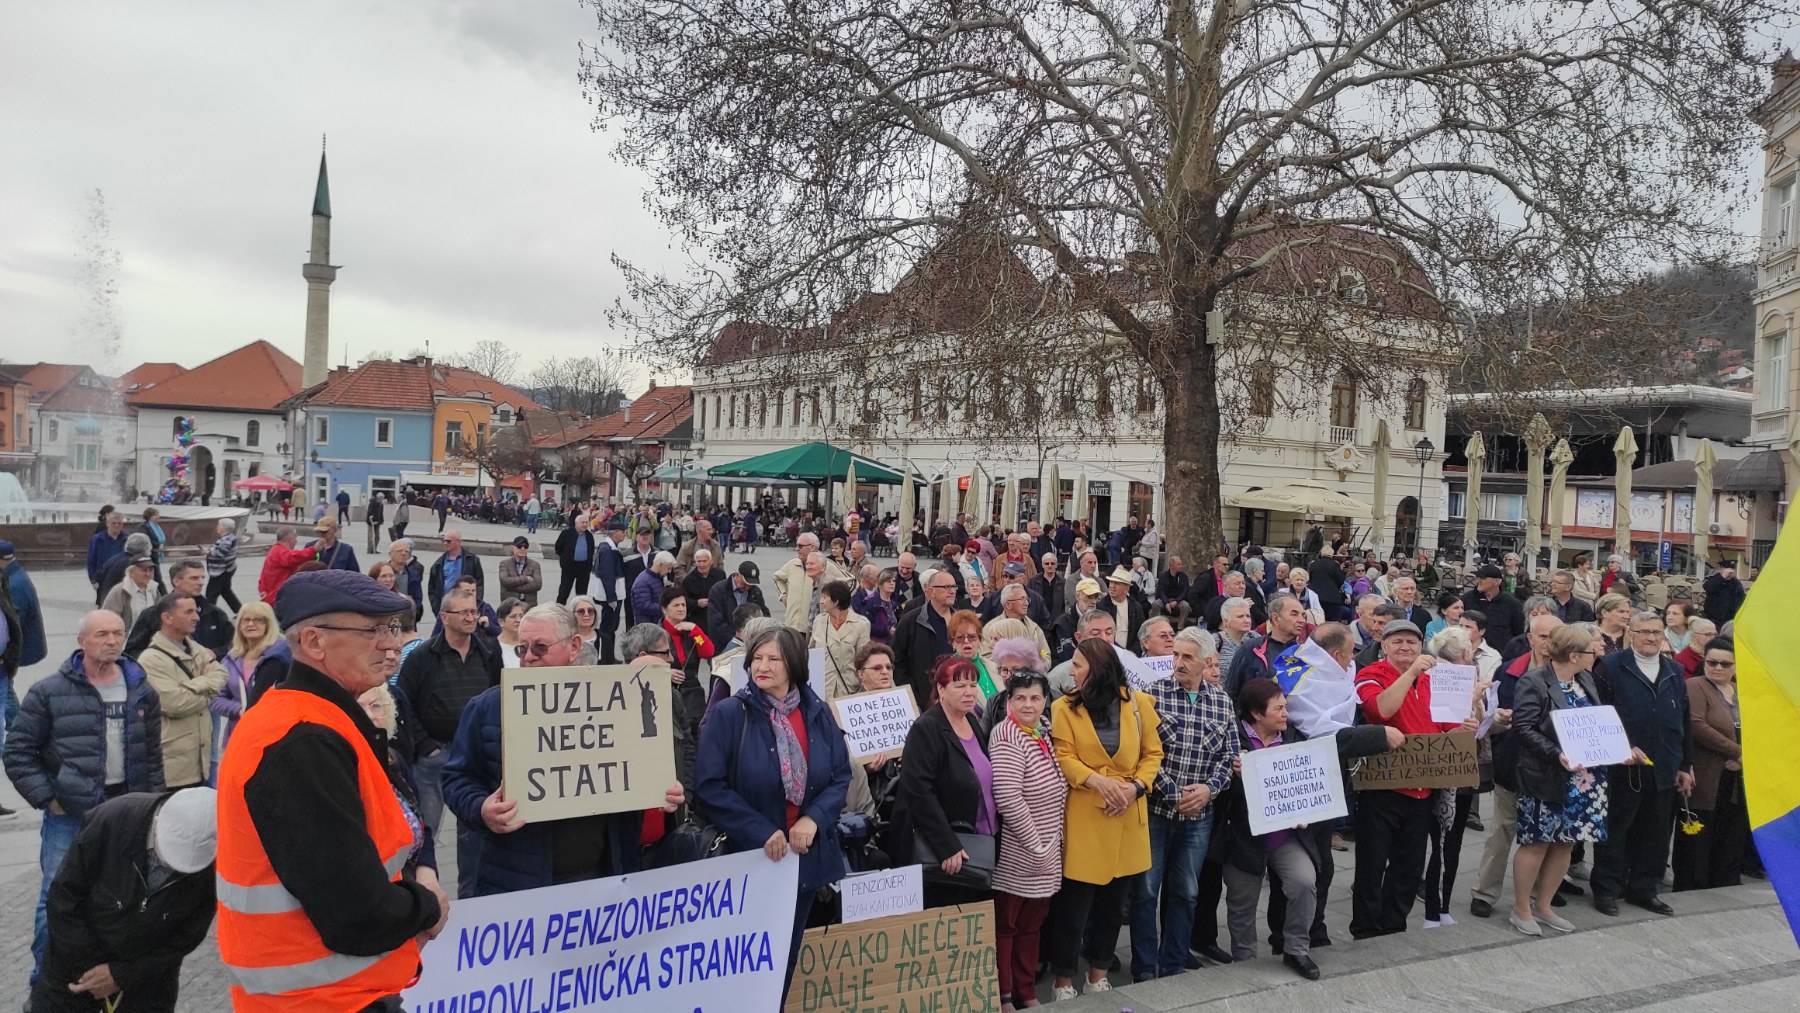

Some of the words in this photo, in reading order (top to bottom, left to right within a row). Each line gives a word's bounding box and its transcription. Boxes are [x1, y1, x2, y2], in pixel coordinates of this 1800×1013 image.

[1664, 542, 1670, 553] P
[513, 681, 627, 715] TUZLA
[847, 703, 862, 714] KO
[864, 699, 879, 711] NE
[880, 695, 901, 708] ŽELI
[849, 716, 866, 728] DA
[866, 712, 880, 724] SE
[881, 708, 906, 720] BORI
[538, 716, 615, 753] NEĆE
[848, 726, 880, 741] NEMA
[860, 741, 875, 752] DA
[877, 737, 890, 748] SE
[890, 733, 907, 746] ŽA
[1272, 754, 1312, 773] POLITIČARI
[1400, 767, 1414, 779] IZ
[528, 760, 629, 802] STATI
[1263, 773, 1289, 789] SISAJU
[1290, 767, 1317, 783] BUDŽET
[1319, 767, 1325, 777] A
[1268, 781, 1325, 802] PENZIONERIMA
[1264, 805, 1276, 817] OD
[1277, 801, 1296, 815] ŠAKE
[1297, 799, 1308, 811] DO
[1309, 793, 1332, 807] LAKTA
[851, 875, 907, 897] PENZIONERI
[458, 919, 535, 972] NOVA
[543, 879, 734, 954] PENZIONERSKA
[800, 931, 888, 975] OVAKO
[900, 912, 985, 959] NEĆETE
[658, 931, 774, 989] STRANKA
